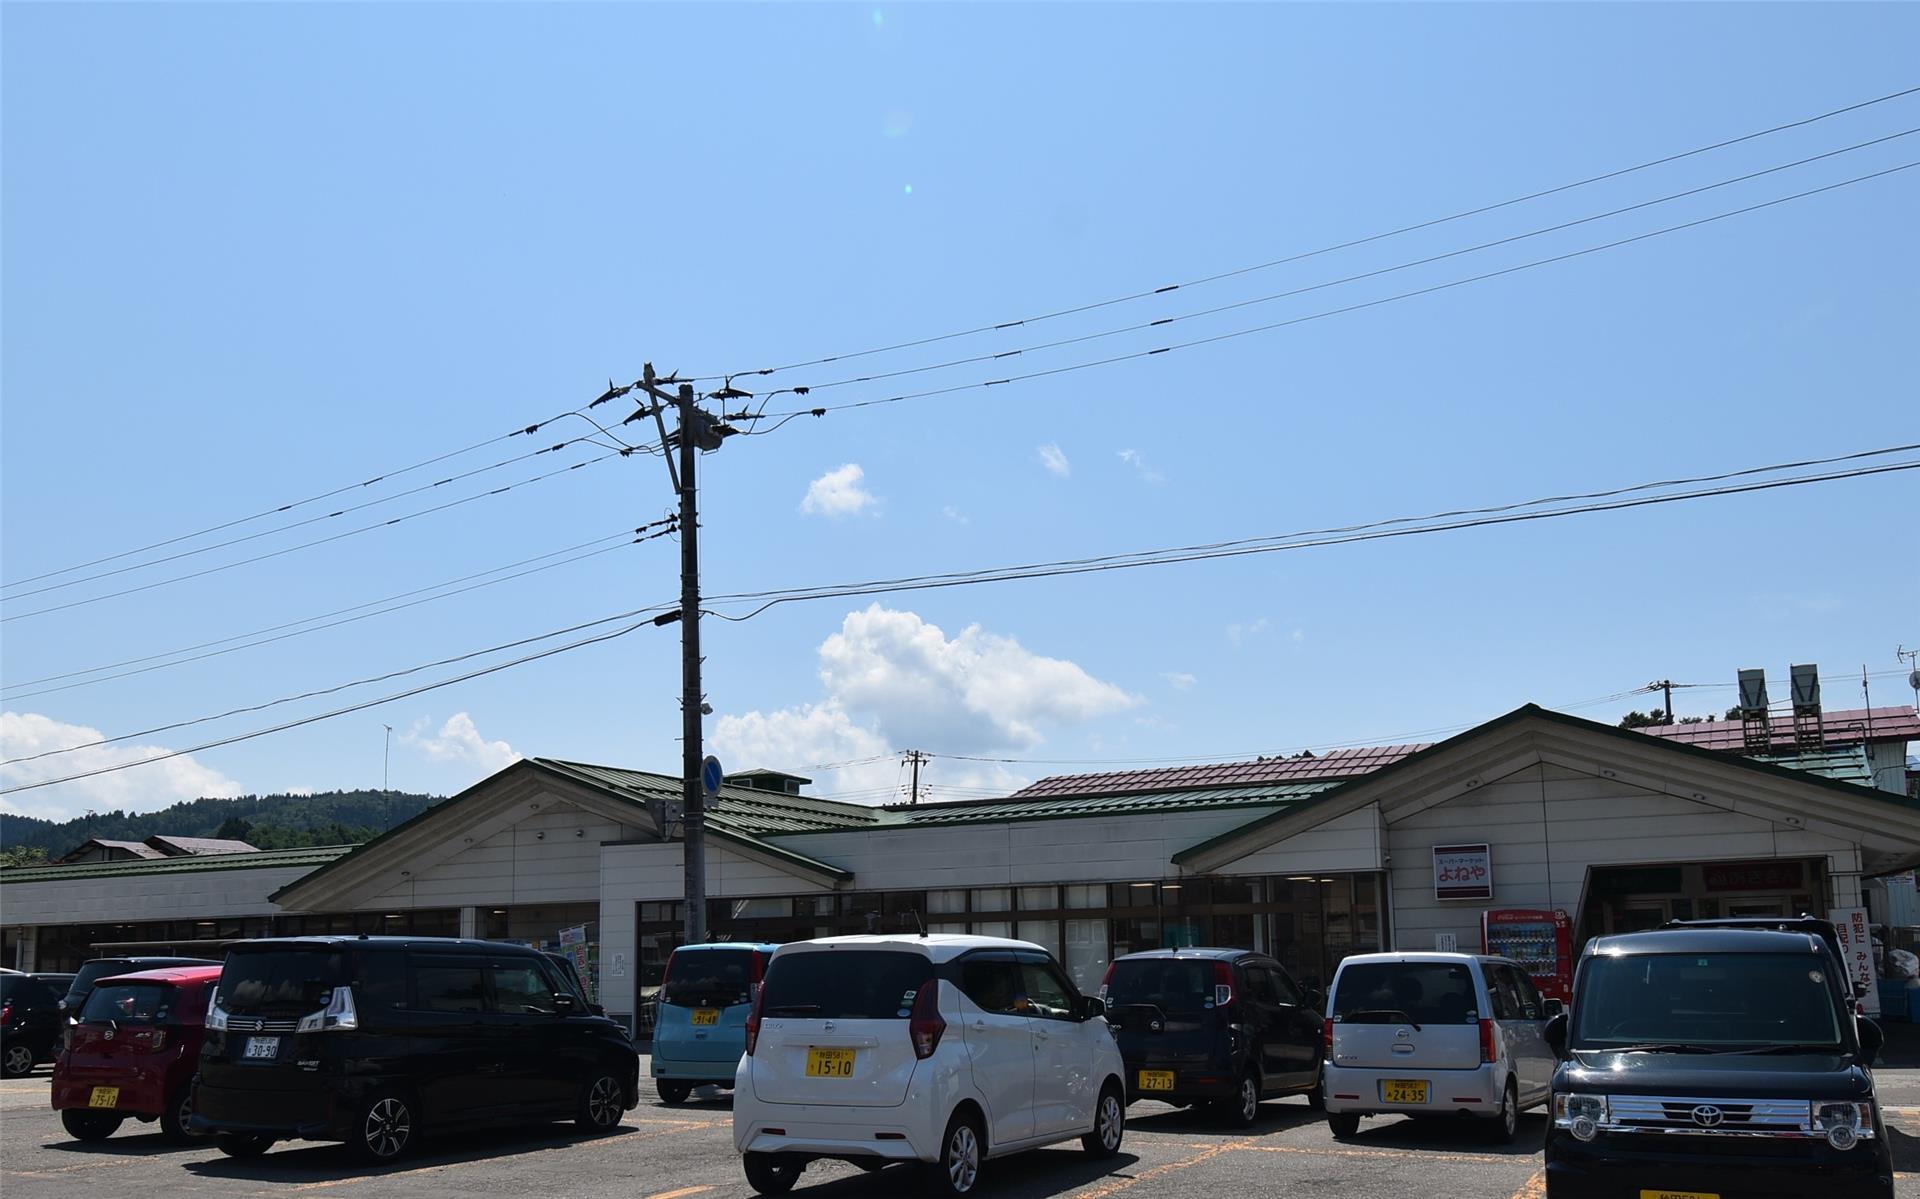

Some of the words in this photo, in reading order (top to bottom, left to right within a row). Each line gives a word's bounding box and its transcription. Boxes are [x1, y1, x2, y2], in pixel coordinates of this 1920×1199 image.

[1438, 857, 1485, 865] スーパーマーケット
[1439, 865, 1486, 882] よねや
[1851, 912, 1865, 944] 防犯に
[252, 1045, 277, 1057] 30-90
[817, 1060, 852, 1075] 15-10
[1146, 1078, 1172, 1089] 27-13
[95, 1094, 116, 1106] 75-12
[1393, 1089, 1425, 1101] 24-35
